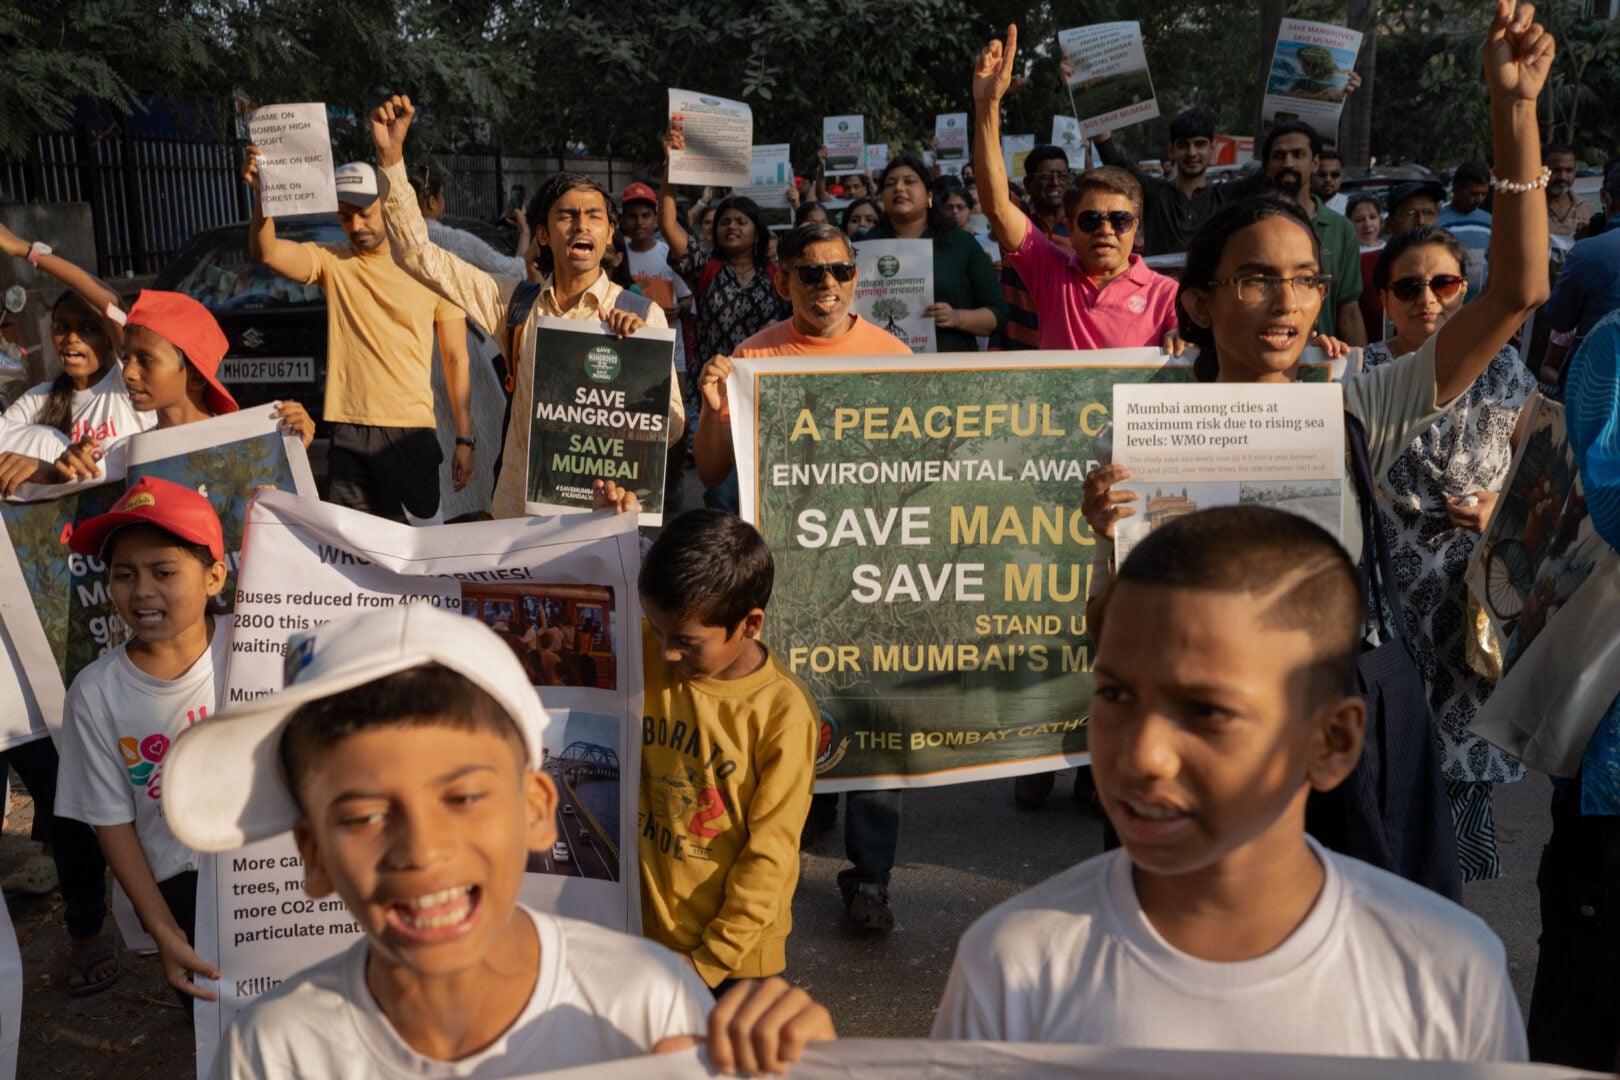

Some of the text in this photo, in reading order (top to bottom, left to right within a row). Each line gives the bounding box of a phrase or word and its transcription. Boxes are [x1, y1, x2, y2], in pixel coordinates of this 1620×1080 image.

[1288, 23, 1354, 41] SAVE MANGROVES
[1293, 34, 1344, 48] SAVE MUMBAI
[1083, 103, 1152, 130] SOS SAVE MUMBAI
[251, 122, 311, 135] BOMBAY HIGH
[253, 137, 283, 146] COURT
[304, 155, 323, 163] BMC
[289, 182, 302, 190] ON
[294, 193, 317, 201] DEPT.
[224, 362, 309, 378] MH02FU6711
[575, 387, 626, 408] SAVE
[536, 402, 663, 432] MANGROVES
[1127, 401, 1278, 416] Mumbai among cities at
[790, 408, 821, 442] A
[834, 403, 1066, 441] PEACEFUL
[1127, 416, 1325, 432] maximum risk due to rising sea
[568, 434, 625, 458] SAVE
[1127, 434, 1248, 448] levels: WMO report
[552, 453, 638, 480] MUMBAI
[1144, 455, 1162, 465] study
[1164, 456, 1180, 465] says
[1195, 454, 1214, 462] levels
[1232, 453, 1241, 462] by
[1275, 454, 1288, 463] year
[1290, 452, 1318, 461] between
[773, 459, 1013, 486] ENVIRONMENTAL
[1147, 466, 1160, 474] and
[1198, 465, 1216, 473] three
[1264, 464, 1293, 472] between
[1312, 463, 1325, 472] and
[796, 505, 1096, 549] SAVE MANG
[851, 563, 985, 604] SAVE
[236, 590, 282, 604] Buses
[286, 591, 352, 607] reduced
[357, 592, 395, 608] from
[445, 595, 461, 608] to
[234, 614, 274, 629] 2800
[279, 615, 309, 629] this
[975, 614, 1061, 636] STAND
[232, 638, 289, 658] waiting
[789, 645, 861, 674] FOR
[873, 644, 1049, 673] MUMBAI'S
[643, 716, 737, 780] BORN TO
[855, 731, 902, 750] THE
[911, 729, 1012, 751] BOMBAY
[233, 858, 275, 872] More
[232, 881, 280, 896] trees,
[234, 905, 277, 920] more
[281, 900, 314, 915] CO2
[234, 923, 325, 947] particulate
